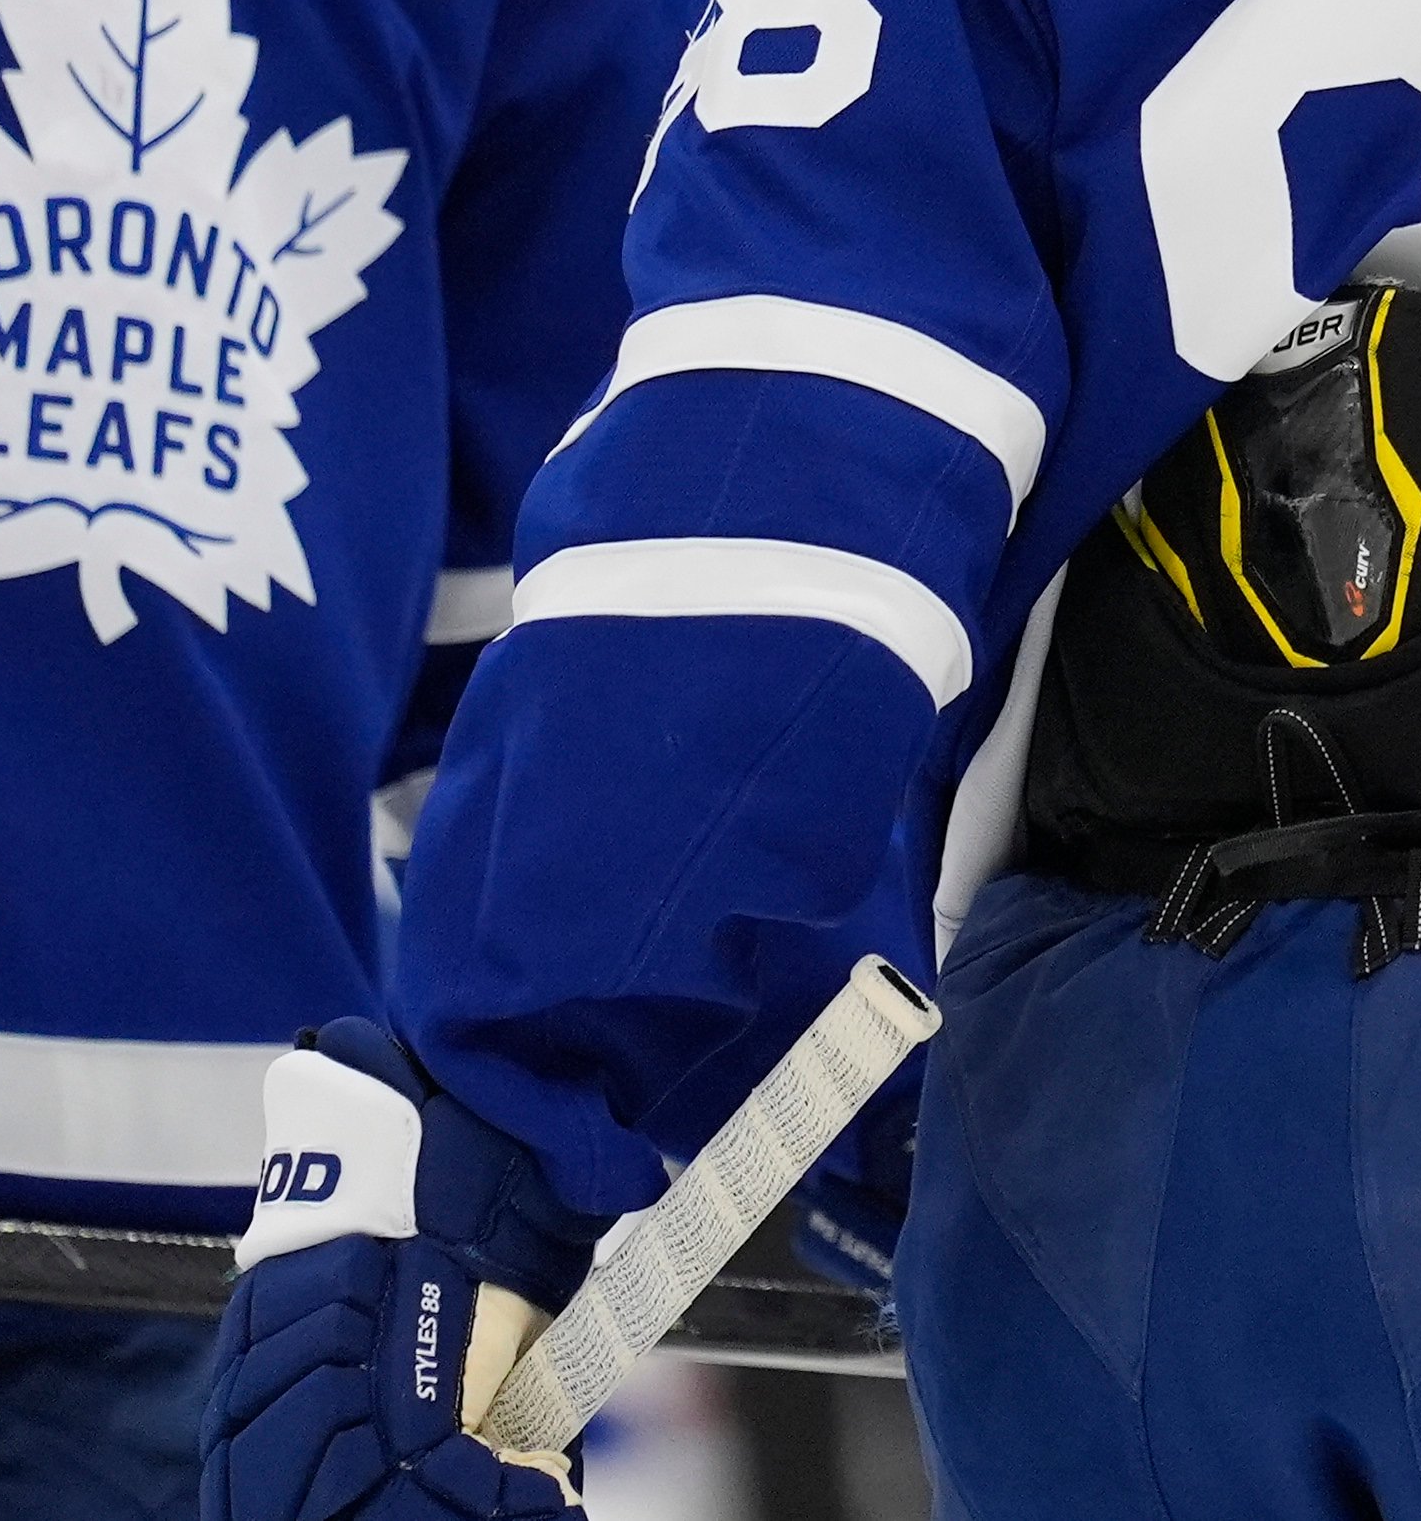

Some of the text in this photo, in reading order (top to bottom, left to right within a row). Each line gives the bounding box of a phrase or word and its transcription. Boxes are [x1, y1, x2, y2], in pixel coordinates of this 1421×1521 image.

[259, 1151, 342, 1203] OD
[415, 1282, 441, 1402] STYLES 88
